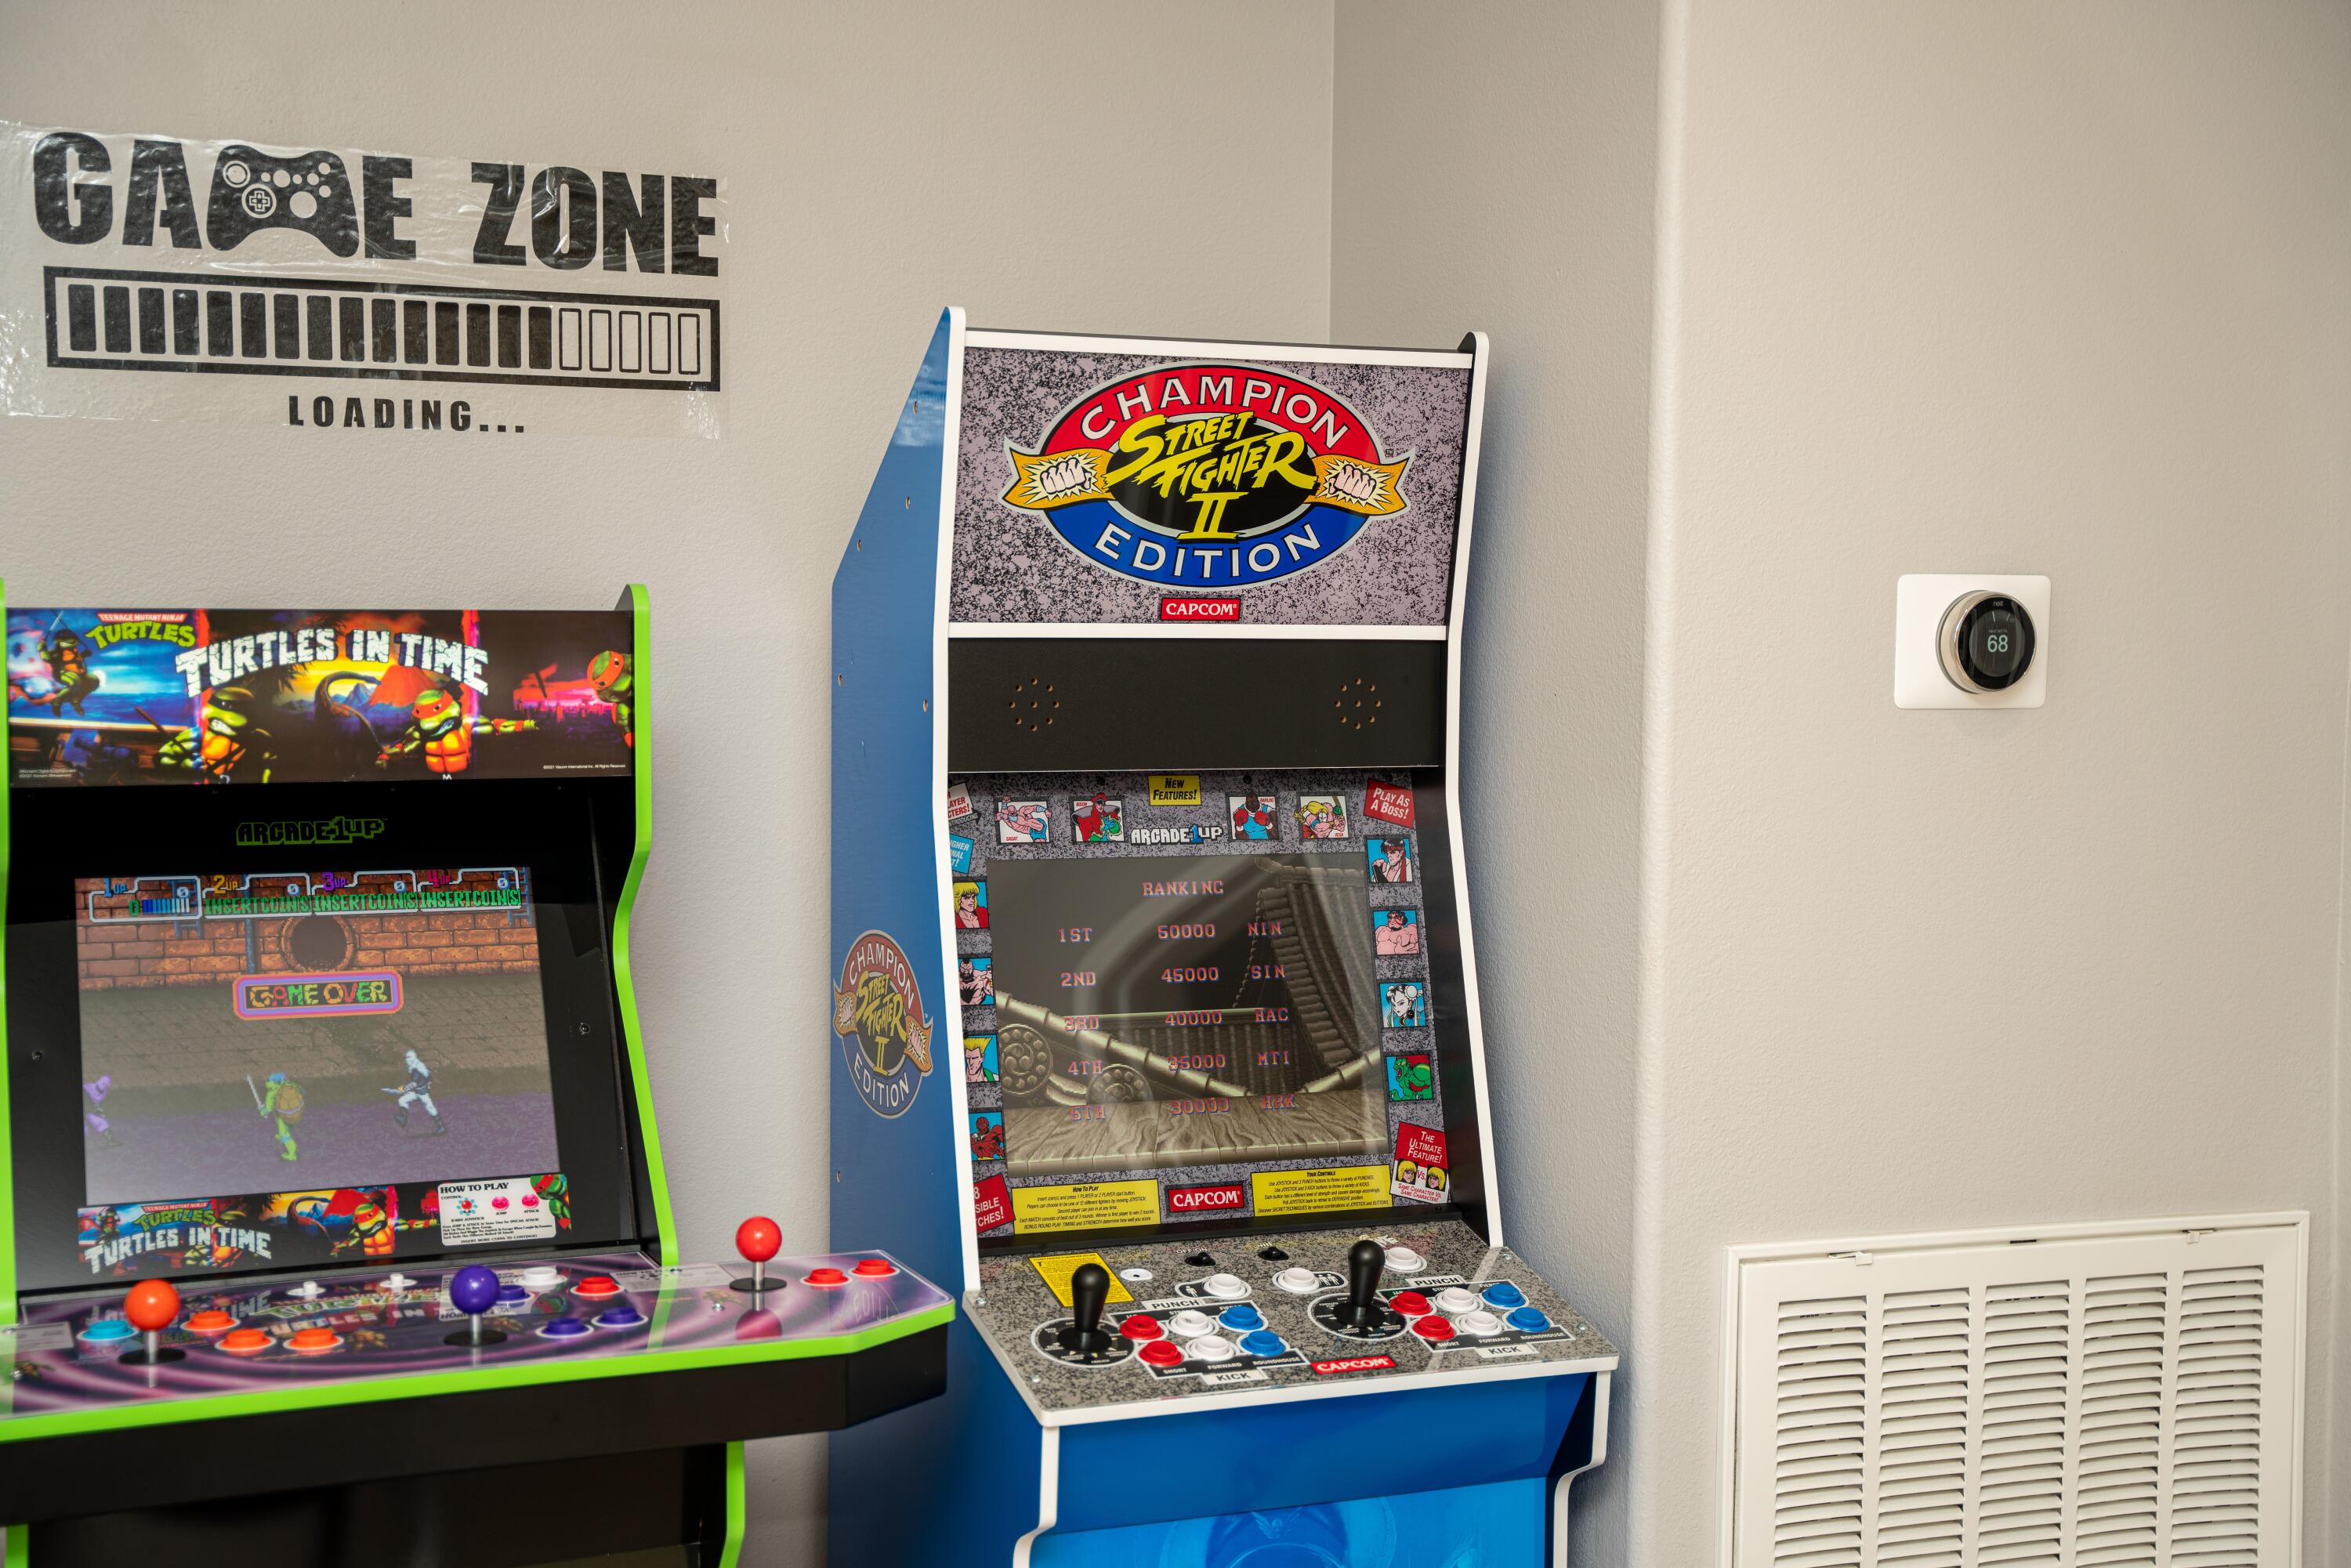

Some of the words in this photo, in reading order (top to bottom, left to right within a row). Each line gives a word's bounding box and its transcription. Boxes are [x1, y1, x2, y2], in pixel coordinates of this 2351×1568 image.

[470, 161, 719, 277] ZONE
[288, 395, 524, 434] LOADING...
[1080, 375, 1349, 449] CHAMPION
[1102, 411, 1254, 489] STREET
[1132, 431, 1317, 498] FIGHTER
[1177, 491, 1249, 539] II
[1095, 522, 1320, 578] EDITION
[85, 620, 195, 649] TURTLES
[1987, 635, 2008, 652] 68
[175, 628, 339, 698] TURTLES
[346, 629, 390, 664] IN
[393, 632, 488, 696] TIME
[1165, 778, 1184, 789] NEW
[947, 797, 965, 809] AYER
[1153, 788, 1197, 801] FEATURES!
[1373, 788, 1396, 802] PLAY
[1396, 795, 1410, 807] AS
[1371, 799, 1378, 809] A
[1382, 802, 1408, 820] BOSS!
[1142, 880, 1224, 896] RANKING
[1060, 928, 1092, 943] 1ST
[1157, 924, 1215, 940] 50000
[1248, 922, 1282, 936] NIN
[849, 943, 915, 1009] CHAMPION
[1060, 972, 1096, 987] 2ND
[1161, 967, 1219, 983] 45000
[1251, 965, 1286, 980] SIN
[250, 983, 319, 1008] GAME
[324, 981, 387, 1004] OVER
[855, 970, 891, 1020] STREET
[862, 992, 907, 1042] FIGHTER
[1165, 1010, 1223, 1027] 40000
[873, 1036, 889, 1077] II
[1067, 1059, 1103, 1076] 4TH
[1168, 1054, 1226, 1071] 35000
[854, 1052, 909, 1108] EDITION
[1070, 1105, 1106, 1121] 5TH
[1171, 1098, 1230, 1115] 30000
[1409, 1138, 1443, 1154] ULTIMATE
[1421, 1131, 1435, 1143] THE
[1407, 1147, 1443, 1164] FEATURE!
[1417, 1171, 1426, 1180] VS.
[440, 1184, 465, 1193] HOW
[466, 1183, 481, 1192] TO
[483, 1182, 509, 1190] PLAY
[1411, 1186, 1435, 1196] CHARACTER
[1413, 1193, 1439, 1202] CHARACTER!
[134, 1208, 216, 1231] TURTLES
[84, 1228, 179, 1274] TURTLES
[189, 1226, 212, 1246] IN
[217, 1227, 271, 1260] TIME
[1414, 1277, 1460, 1286] PUNCH
[1151, 1299, 1200, 1309] PUNCH
[1520, 1331, 1565, 1340] ROUNDHOUSE
[1487, 1345, 1521, 1355] KICK
[1253, 1356, 1301, 1366] ROUNDHOUSE
[1216, 1371, 1252, 1382] KICK
